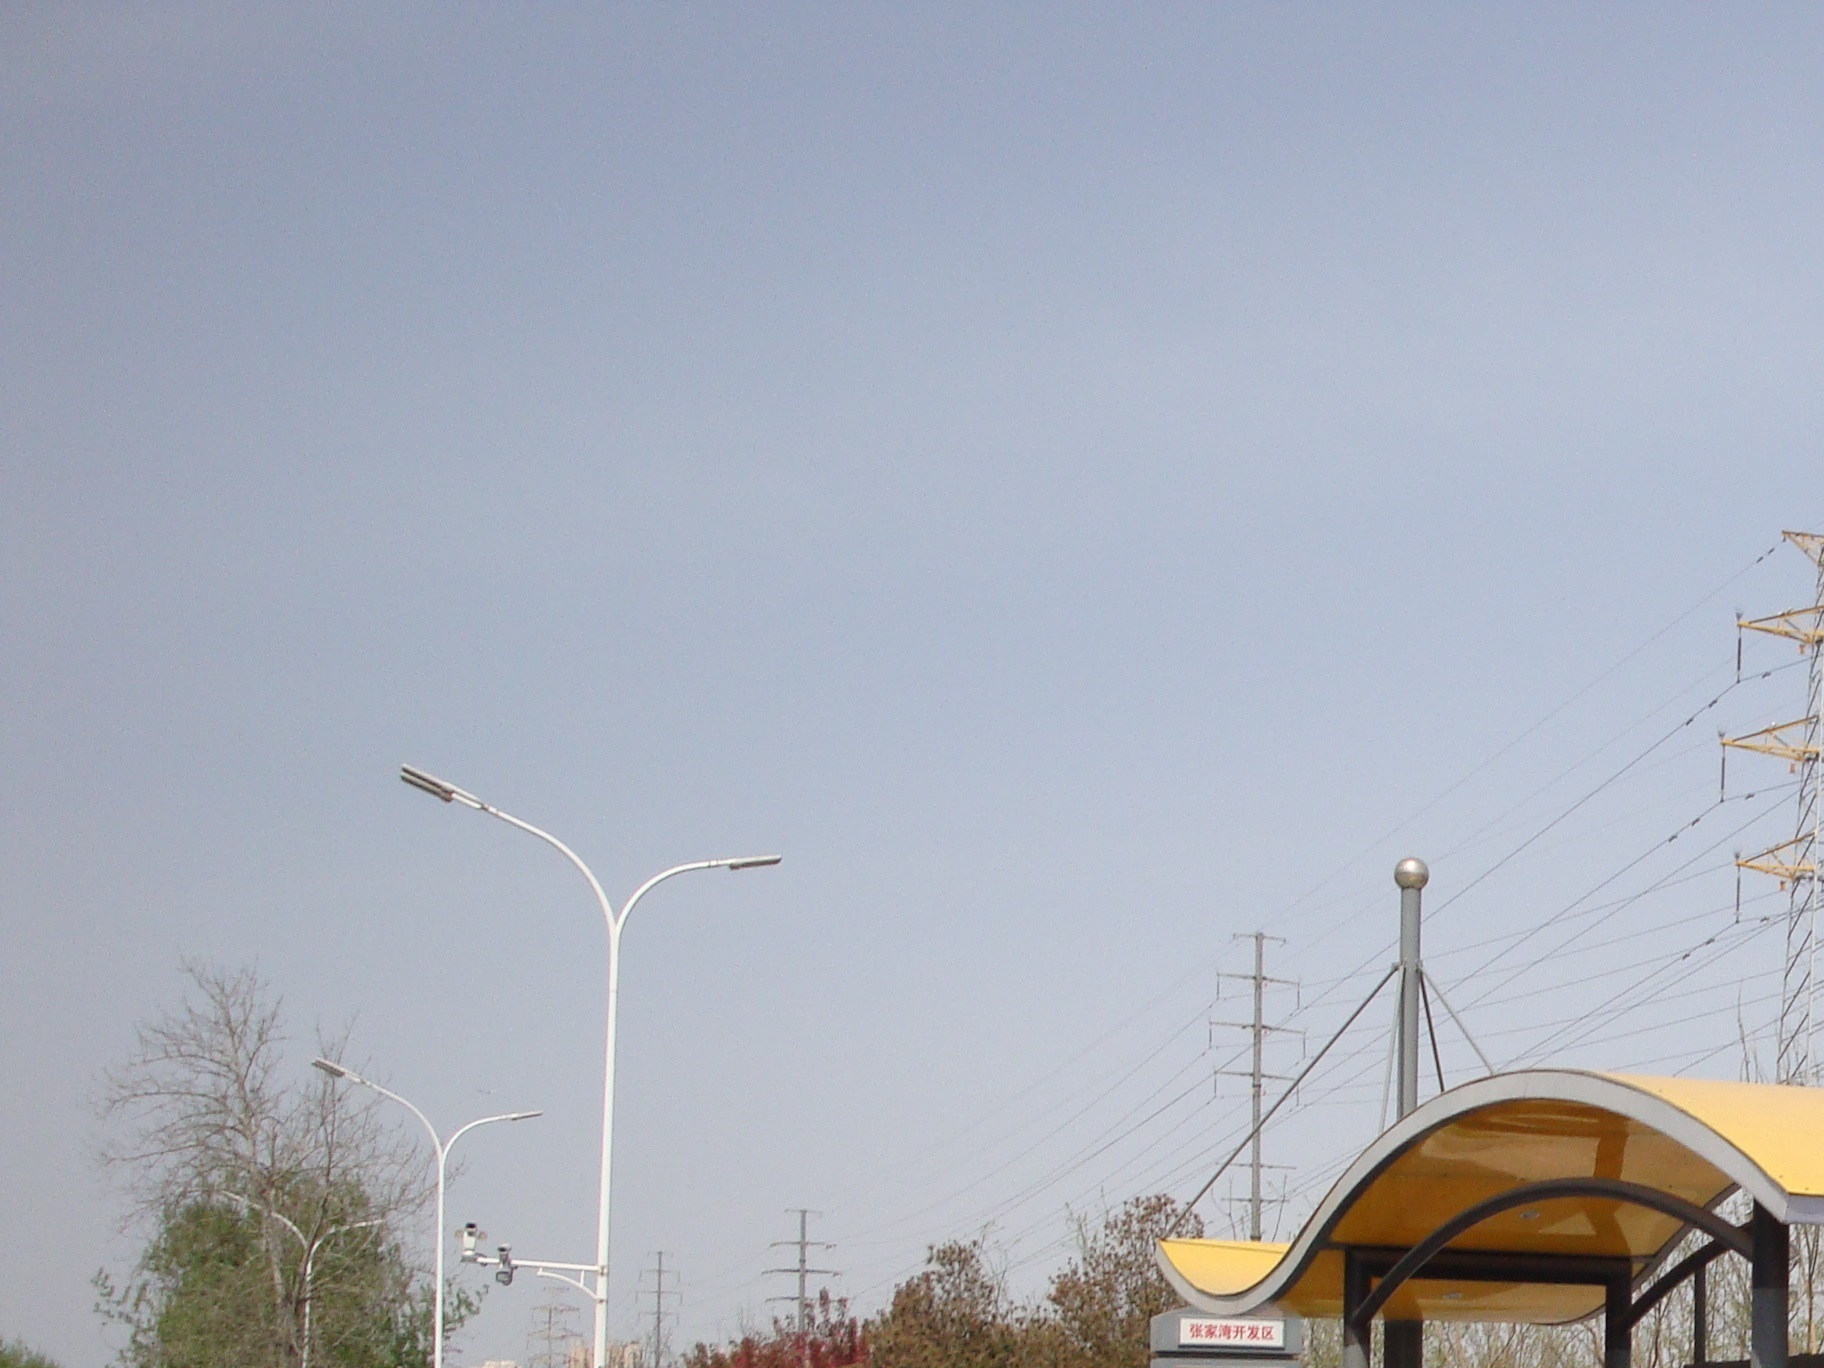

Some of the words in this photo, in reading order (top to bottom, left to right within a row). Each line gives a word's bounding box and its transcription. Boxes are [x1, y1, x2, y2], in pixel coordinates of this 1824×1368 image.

[1189, 1323, 1274, 1340] 张家湾开发区
